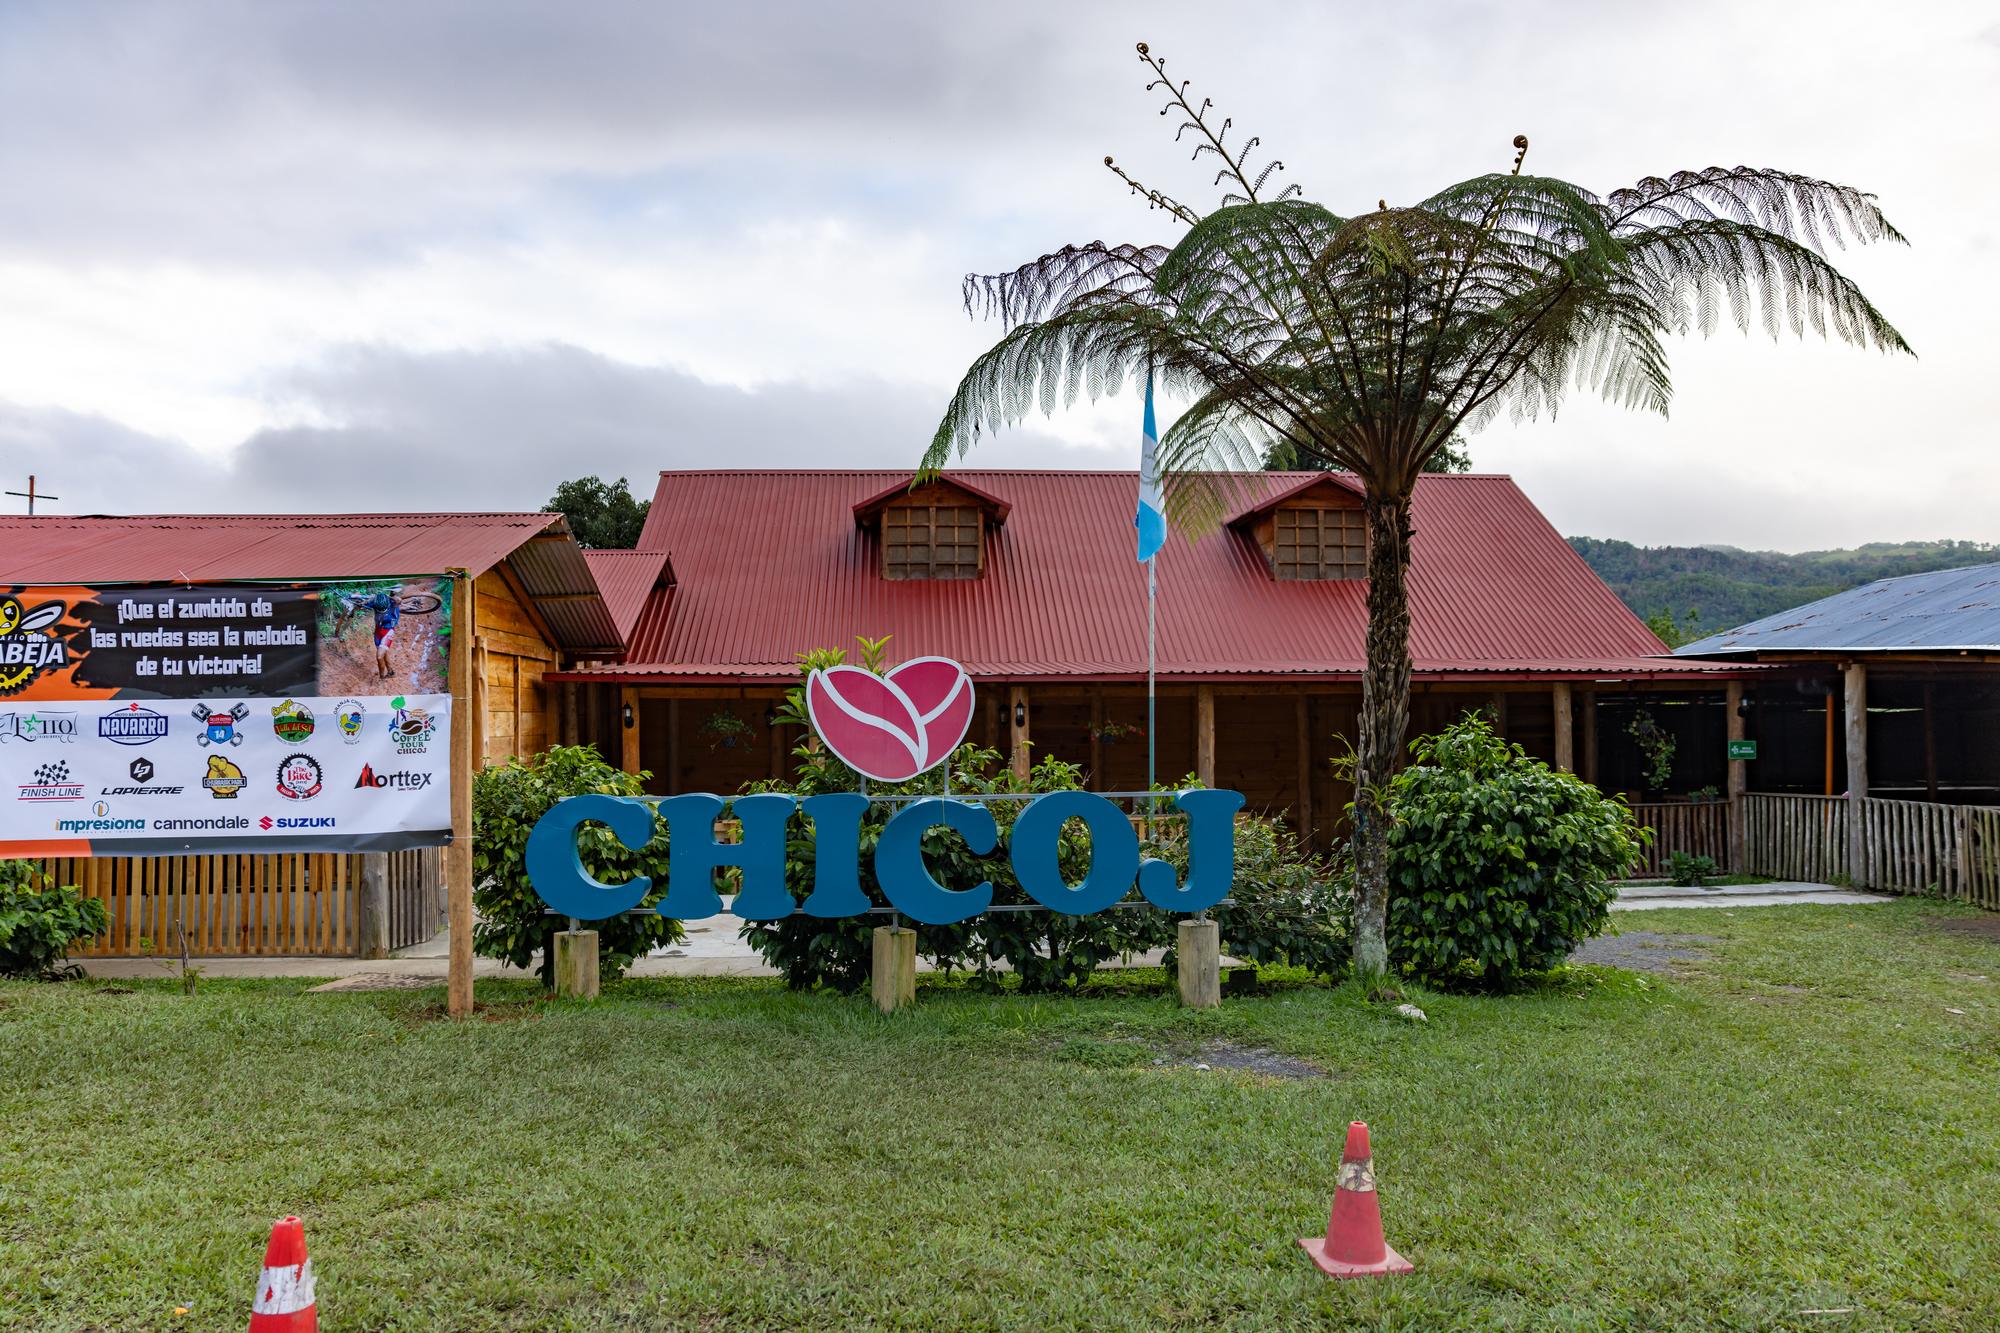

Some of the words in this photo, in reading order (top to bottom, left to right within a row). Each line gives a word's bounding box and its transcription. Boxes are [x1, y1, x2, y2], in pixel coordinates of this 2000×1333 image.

[117, 599, 153, 624] ¡Que
[158, 598, 174, 618] el
[178, 597, 247, 618] zumbido
[251, 597, 273, 617] de
[90, 628, 117, 648] las
[122, 627, 184, 648] ruedas
[188, 630, 219, 647] sea
[224, 625, 240, 646] la
[244, 624, 307, 646] melodía
[136, 656, 157, 676] de
[163, 657, 182, 675] tu
[187, 653, 262, 676] victoria!
[101, 717, 166, 735] NAVARRO
[392, 729, 431, 743] COFFEE
[400, 741, 424, 749] TOUR
[288, 769, 313, 781] Bike
[20, 788, 57, 797] FINISH
[58, 787, 81, 797] LINE
[101, 786, 184, 795] LAPIERRE
[55, 817, 146, 834] impresiona
[153, 815, 249, 830] cannondale
[277, 817, 335, 828] SUZUKI
[525, 788, 1246, 925] CHICOJ
